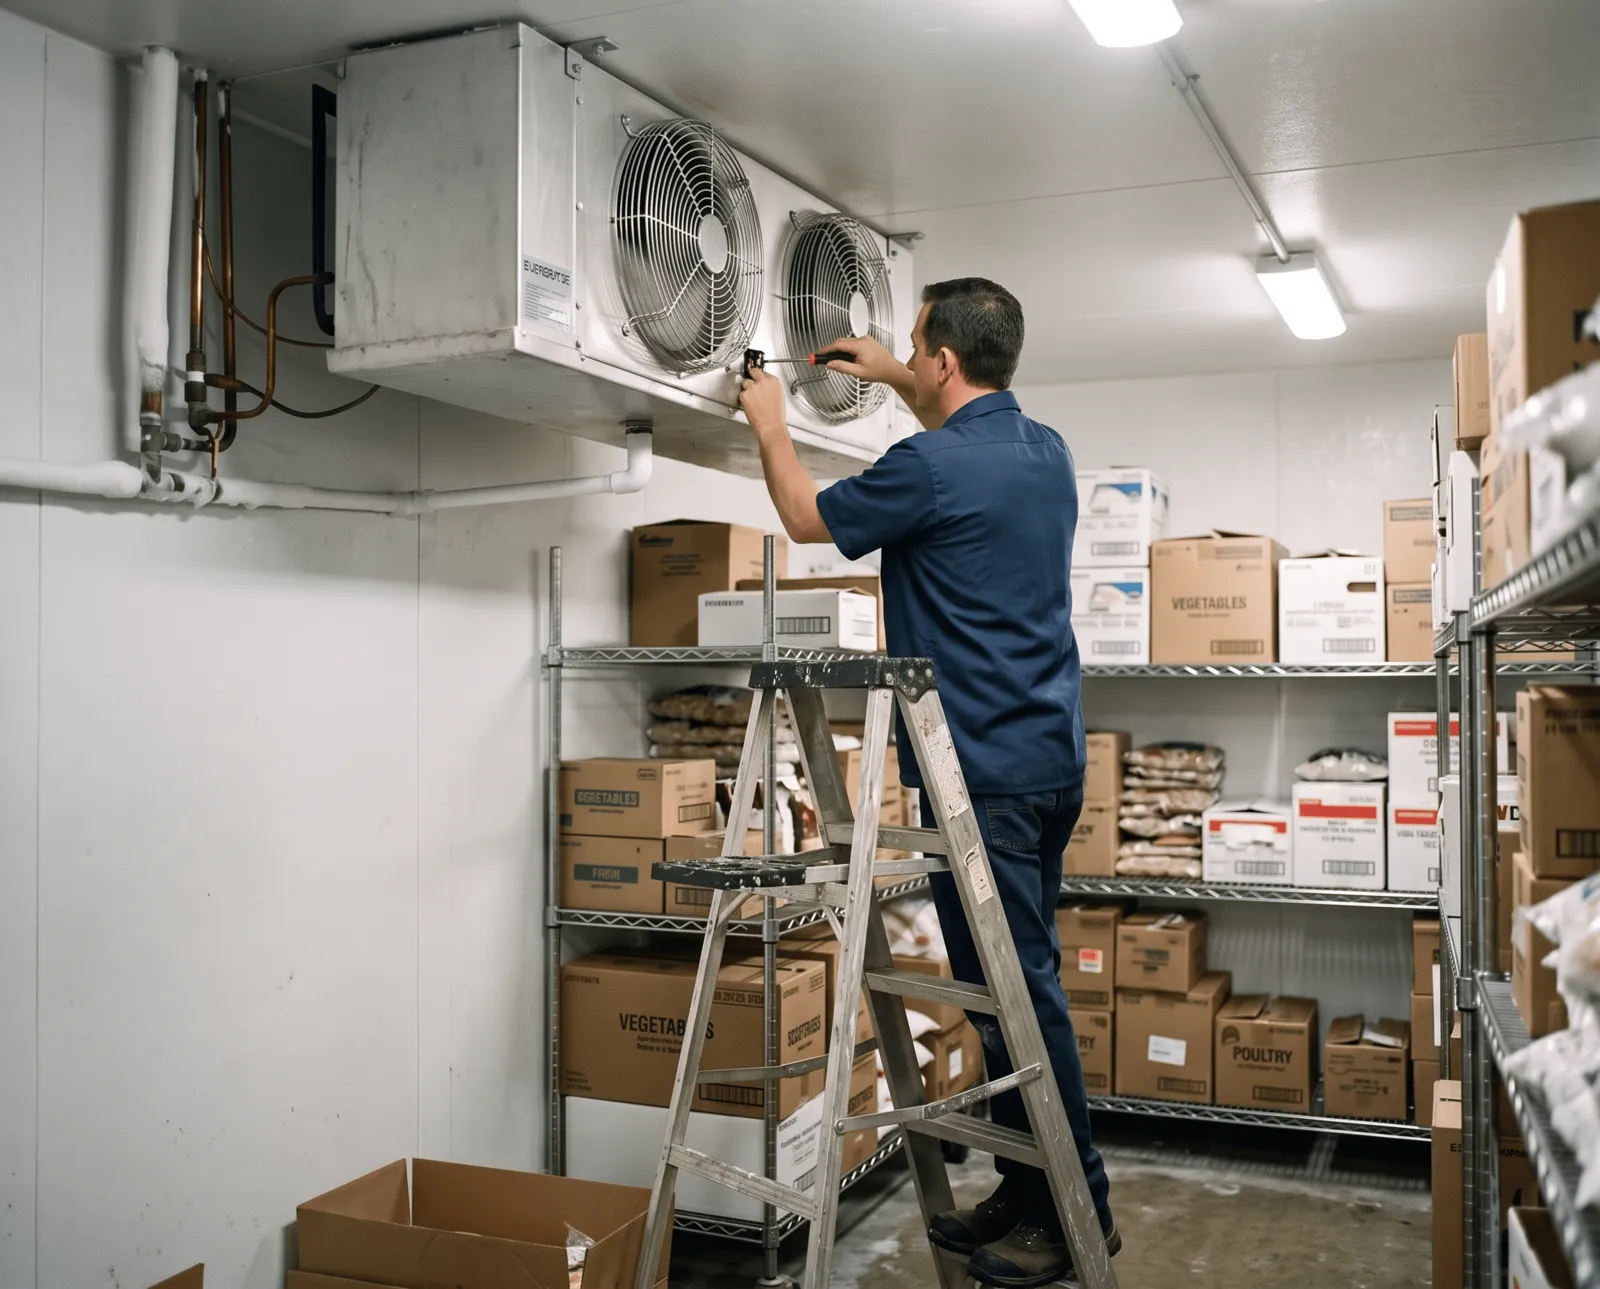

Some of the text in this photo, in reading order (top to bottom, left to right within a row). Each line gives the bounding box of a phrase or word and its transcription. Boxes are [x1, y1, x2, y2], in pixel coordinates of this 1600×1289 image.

[1172, 596, 1247, 610] VEGETABLES
[619, 1013, 715, 1040] VEGETABS
[1233, 1046, 1293, 1064] POULTRY
